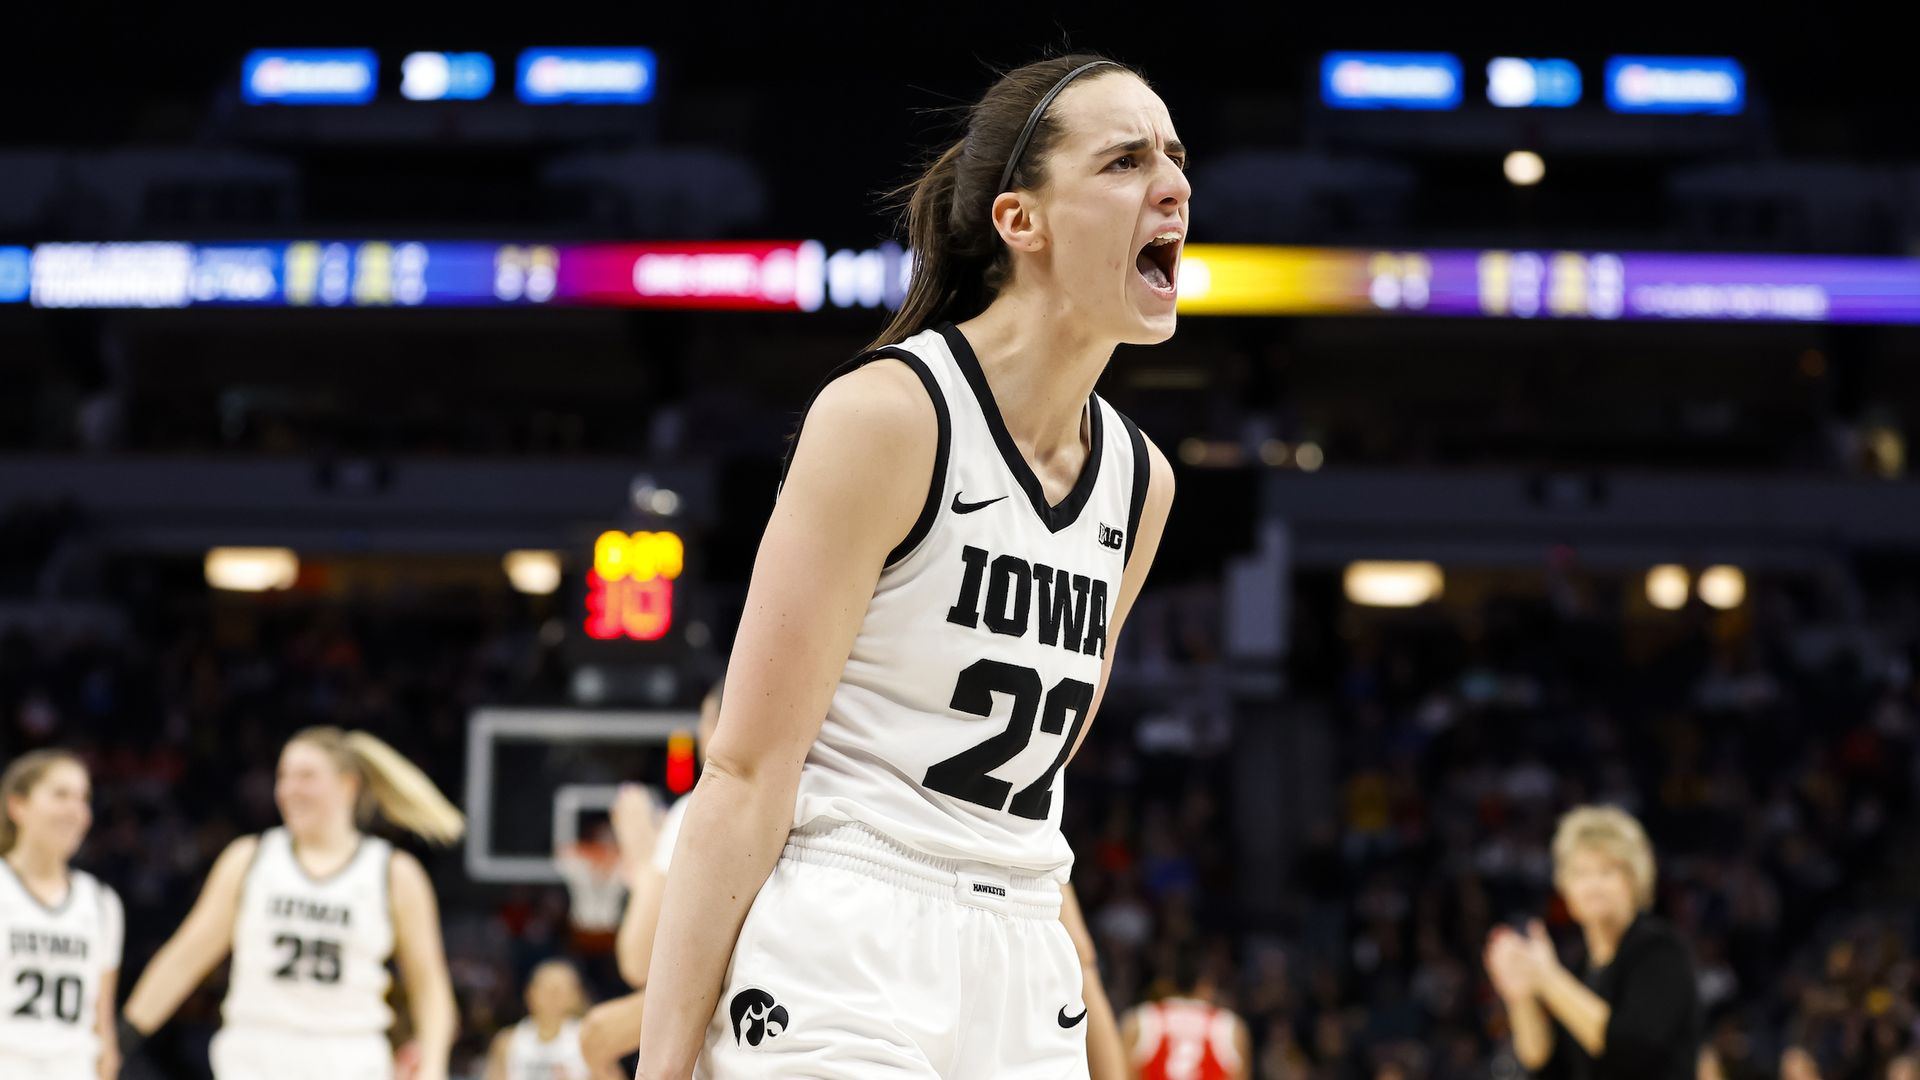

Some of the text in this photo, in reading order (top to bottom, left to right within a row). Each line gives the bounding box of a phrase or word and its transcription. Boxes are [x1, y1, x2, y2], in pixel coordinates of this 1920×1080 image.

[946, 544, 1107, 660] IOWA
[922, 658, 1094, 820] 22
[973, 883, 1006, 897] HAWKEYES
[272, 932, 345, 986] 25
[13, 968, 84, 1026] 20
